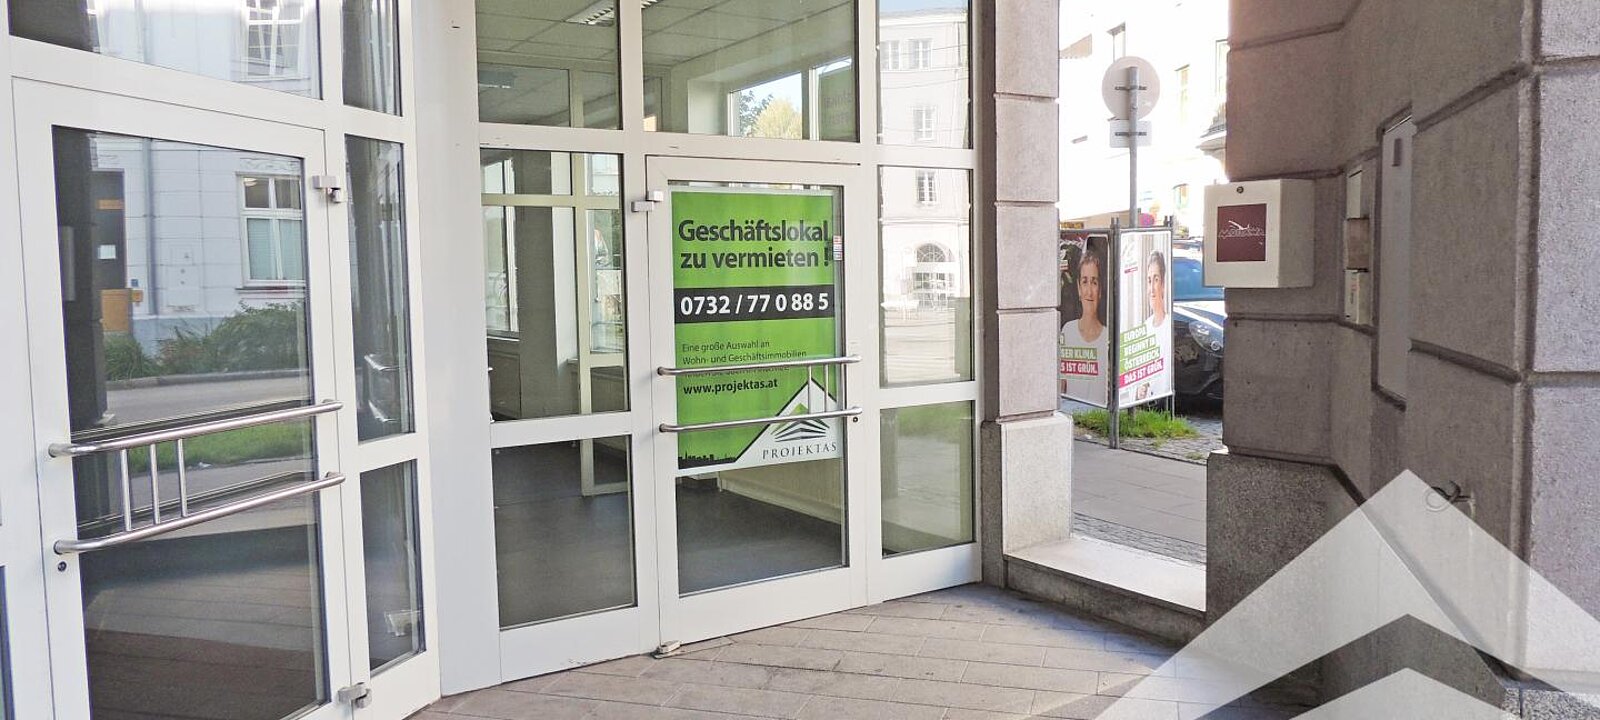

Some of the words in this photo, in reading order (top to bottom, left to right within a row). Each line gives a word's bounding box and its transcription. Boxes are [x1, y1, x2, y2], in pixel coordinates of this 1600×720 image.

[678, 219, 829, 242] Geschäftslokal
[680, 252, 706, 268] zu
[712, 247, 818, 268] vermieten
[824, 246, 829, 267] !
[680, 295, 730, 316] 0732
[735, 294, 743, 314] /
[748, 294, 770, 313] 77
[775, 293, 788, 312] 0
[791, 292, 814, 311] 88
[818, 292, 829, 310] 5
[1124, 326, 1146, 342] EUROPA
[682, 344, 700, 352] Eine
[700, 342, 725, 352] große
[726, 340, 758, 350] Auswahl
[760, 340, 770, 348] an
[1075, 349, 1096, 360] KLIMA.
[682, 356, 708, 365] Wohn-
[711, 354, 726, 363] und
[728, 350, 807, 362] Geschäftsimmobilien
[1066, 362, 1076, 372] IST
[1124, 371, 1136, 384] DAS
[1137, 366, 1146, 378] IST
[684, 378, 778, 396] www.projektas.at
[762, 442, 837, 460] PROJEKTAS
